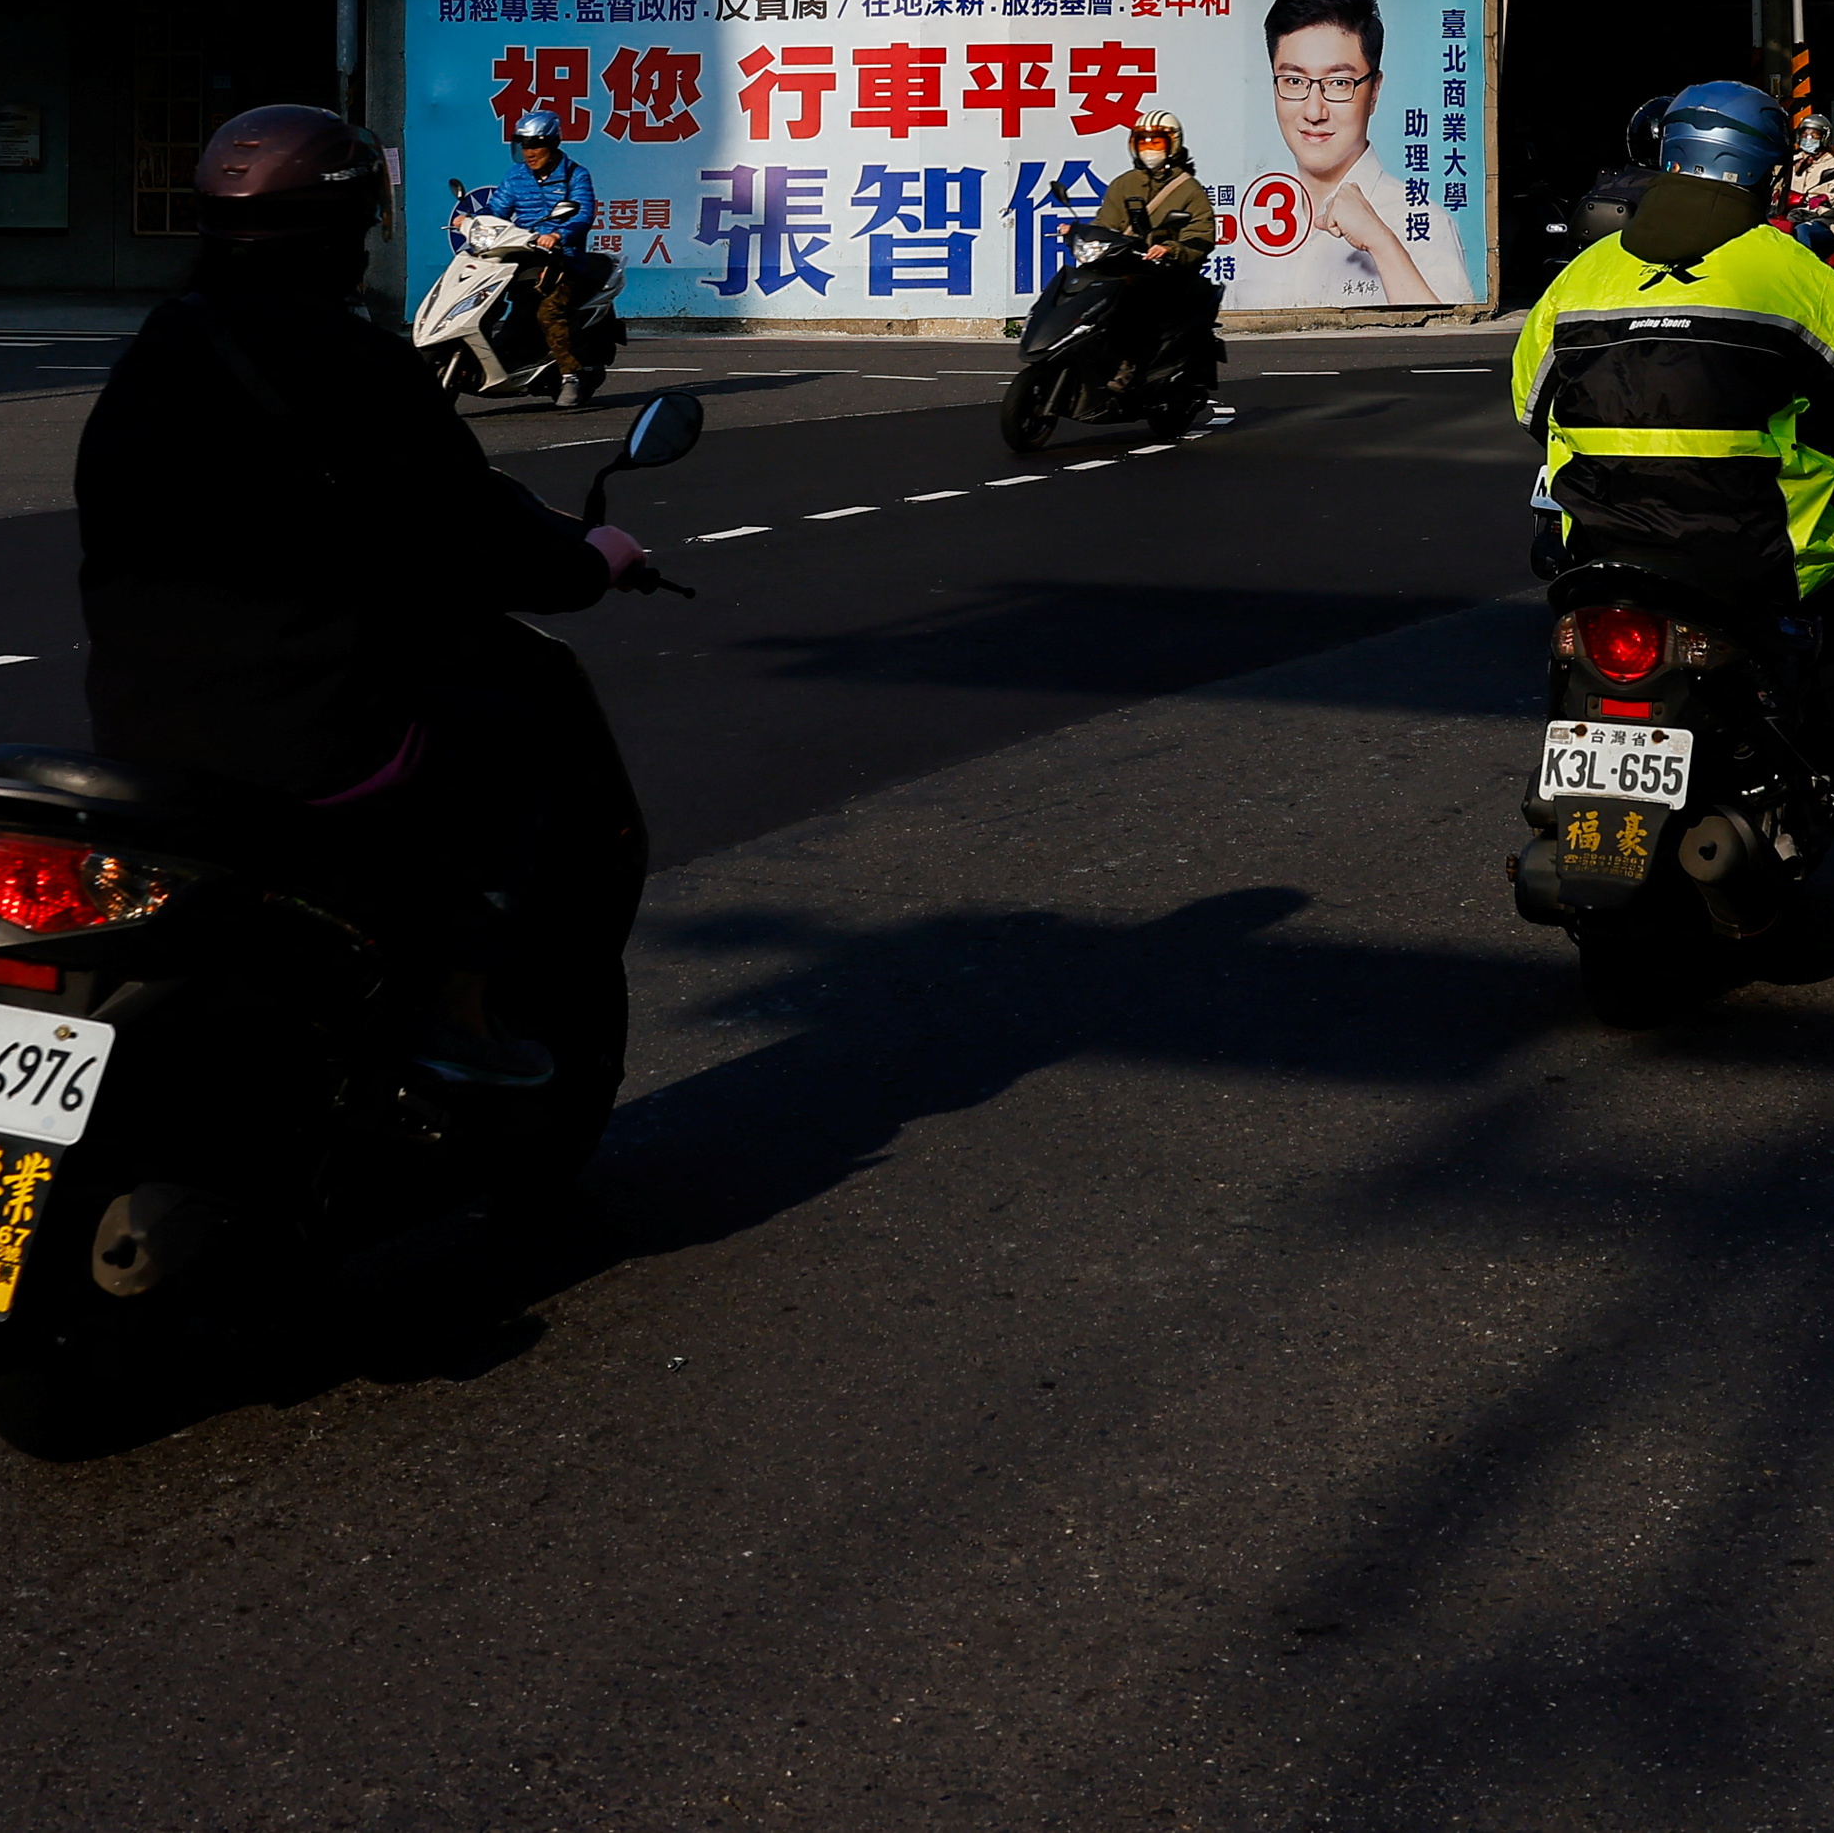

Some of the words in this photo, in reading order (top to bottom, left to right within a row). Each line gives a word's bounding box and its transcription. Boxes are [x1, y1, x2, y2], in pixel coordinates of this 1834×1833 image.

[491, 45, 703, 144] 祝您
[736, 40, 1158, 142] 行車平安
[1441, 9, 1468, 213] 臺北商業大學
[1253, 181, 1296, 247] 3
[1404, 107, 1431, 243] 助理教授
[1590, 728, 1647, 747] 台灣省
[1565, 810, 1649, 857] 福豪
